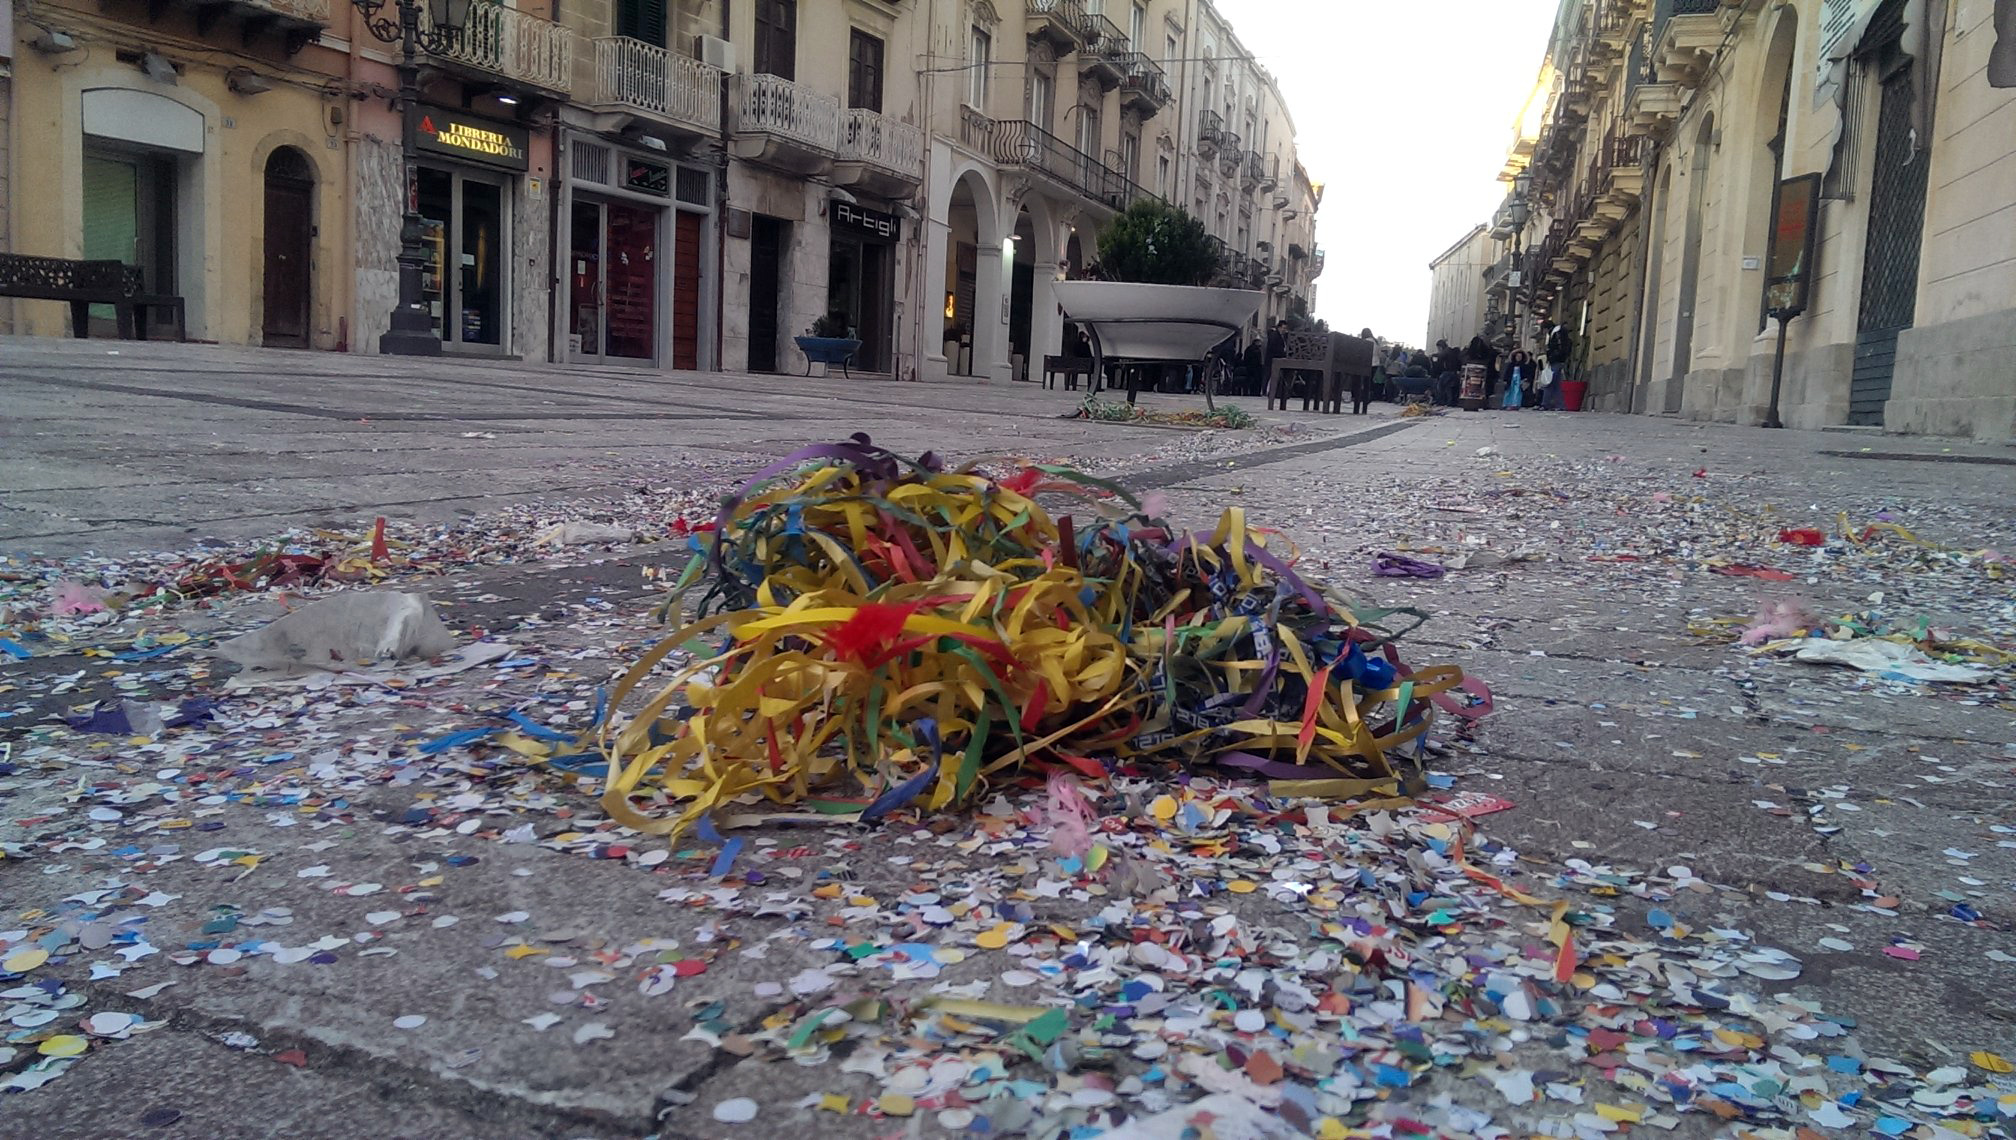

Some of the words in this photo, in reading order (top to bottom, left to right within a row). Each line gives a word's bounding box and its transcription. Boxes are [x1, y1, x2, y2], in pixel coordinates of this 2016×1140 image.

[437, 131, 523, 160] MONDADORI
[449, 123, 512, 147] LIBRERIA
[838, 204, 897, 237] Artigli
